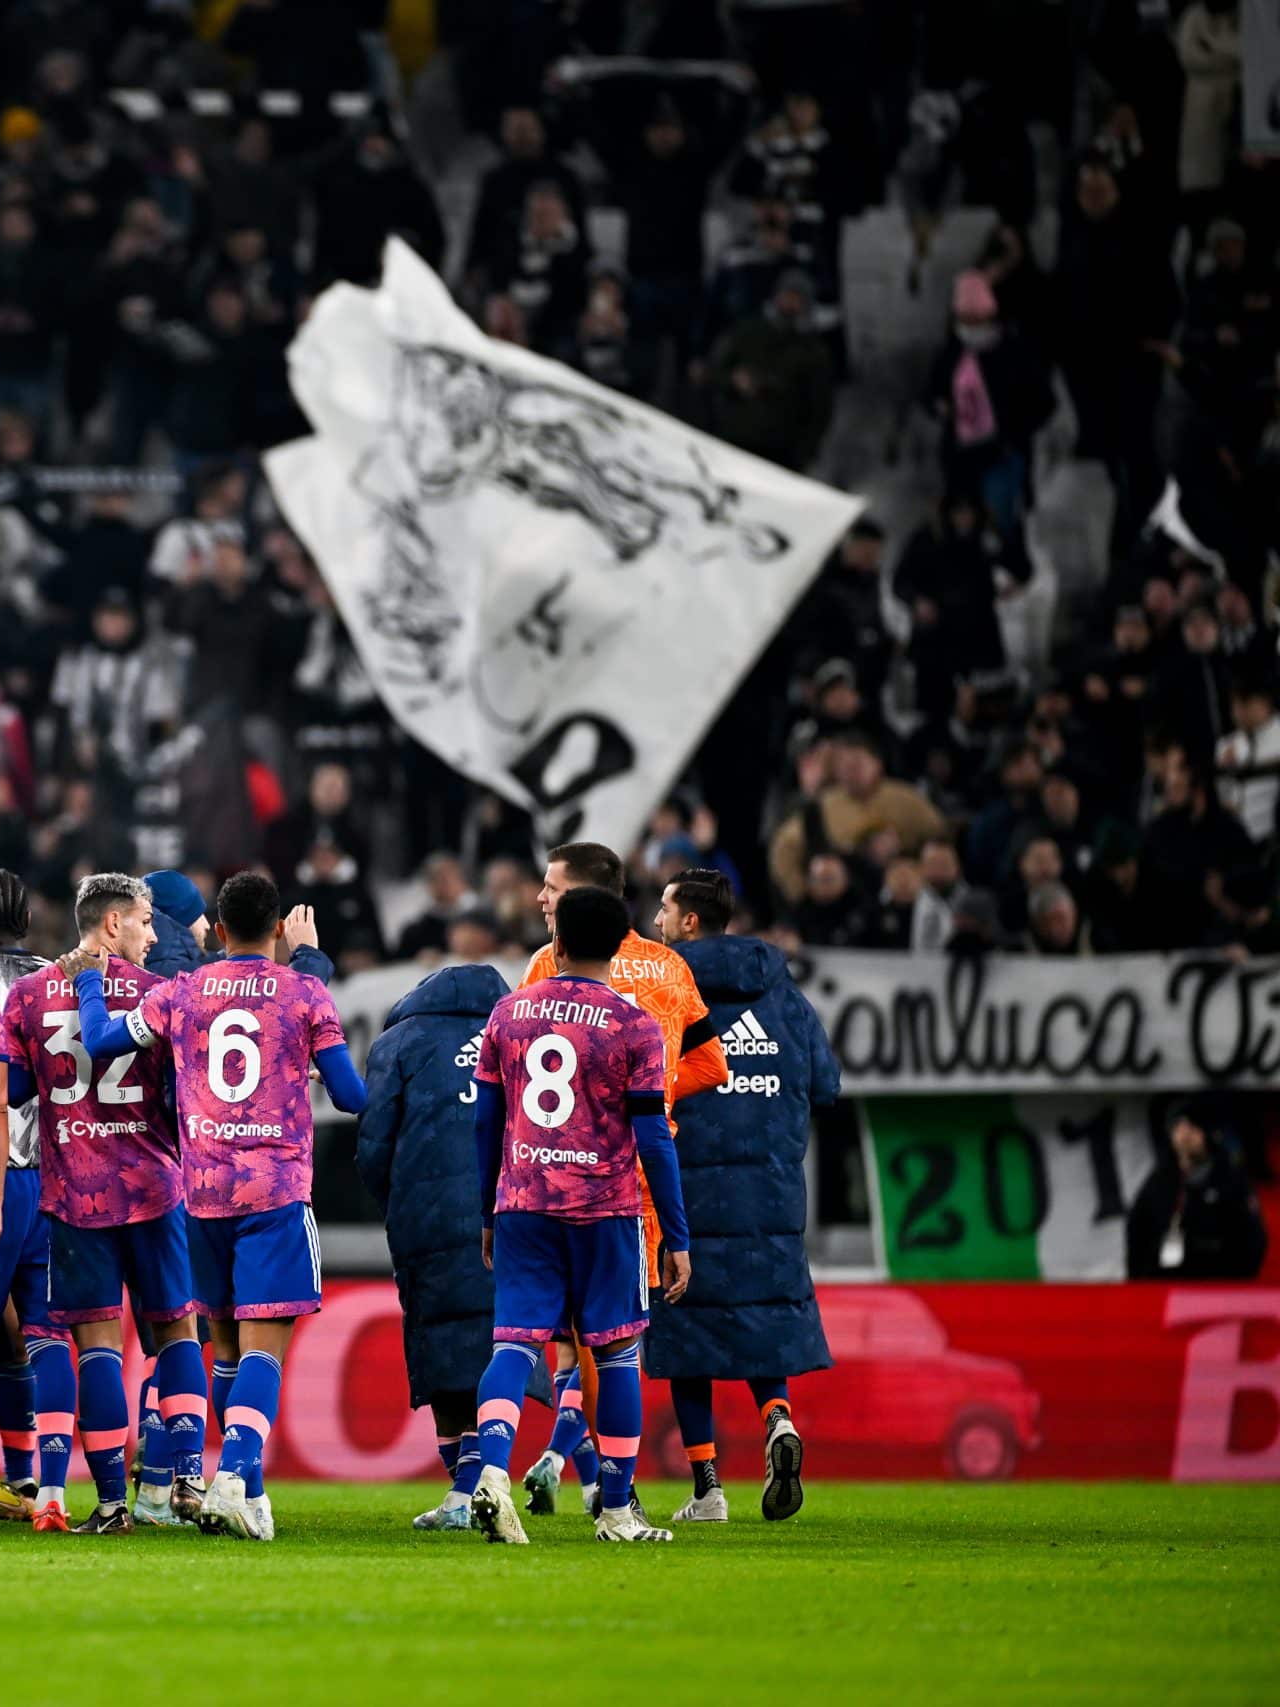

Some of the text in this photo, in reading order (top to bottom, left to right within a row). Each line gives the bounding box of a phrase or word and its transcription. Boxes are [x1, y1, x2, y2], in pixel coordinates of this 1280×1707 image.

[47, 979, 138, 998] PADES
[203, 978, 277, 997] DANILO
[512, 999, 612, 1029] McKENNIE
[780, 952, 1163, 1080] anluca
[43, 1009, 143, 1104] 32
[208, 1009, 261, 1103] 6
[522, 1034, 577, 1128] 8
[716, 1070, 781, 1097] Jeep
[71, 1120, 147, 1138] Cygames
[200, 1119, 282, 1140] Cygames
[519, 1143, 599, 1165] Cygames
